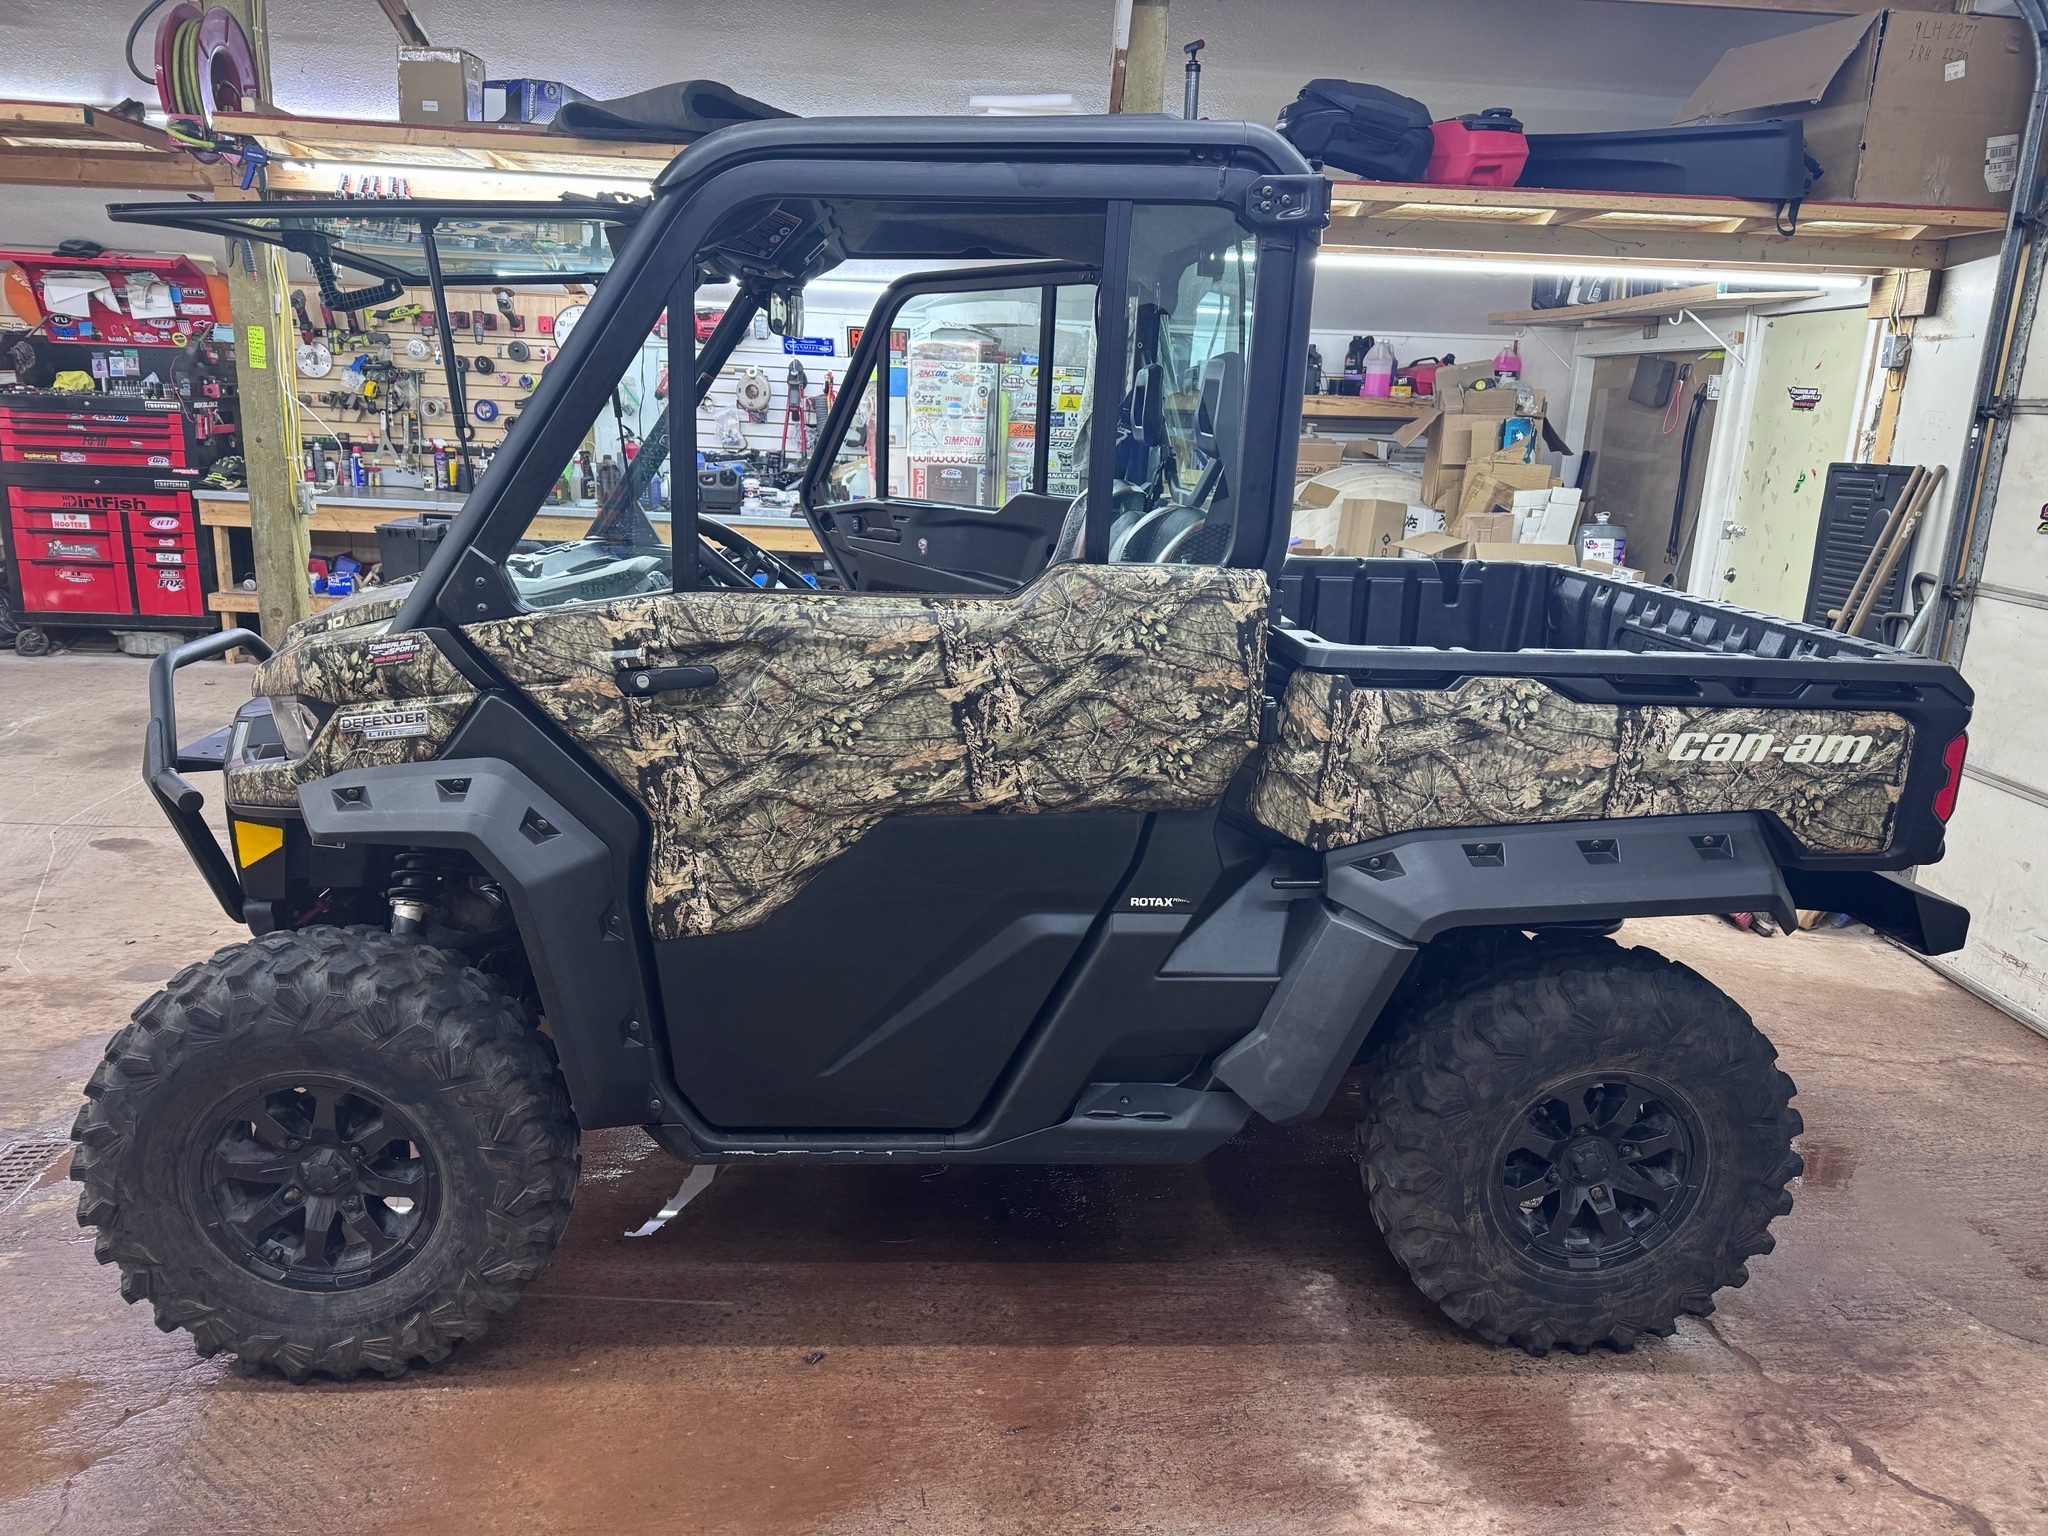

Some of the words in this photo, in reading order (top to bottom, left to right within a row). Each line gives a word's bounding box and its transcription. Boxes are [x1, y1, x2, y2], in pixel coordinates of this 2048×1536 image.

[182, 289, 205, 297] RTFM
[916, 369, 948, 378] AMSOIL
[943, 435, 982, 446] SIMPSON
[61, 495, 147, 510] DirtFish
[54, 520, 88, 528] HOOTERS
[157, 579, 183, 588] FOX
[368, 639, 414, 651] TIMBERLINE
[389, 643, 421, 655] SPORTS
[342, 712, 426, 729] DEFENDER
[1667, 732, 1874, 764] can-am
[1130, 897, 1173, 907] ROTAX
